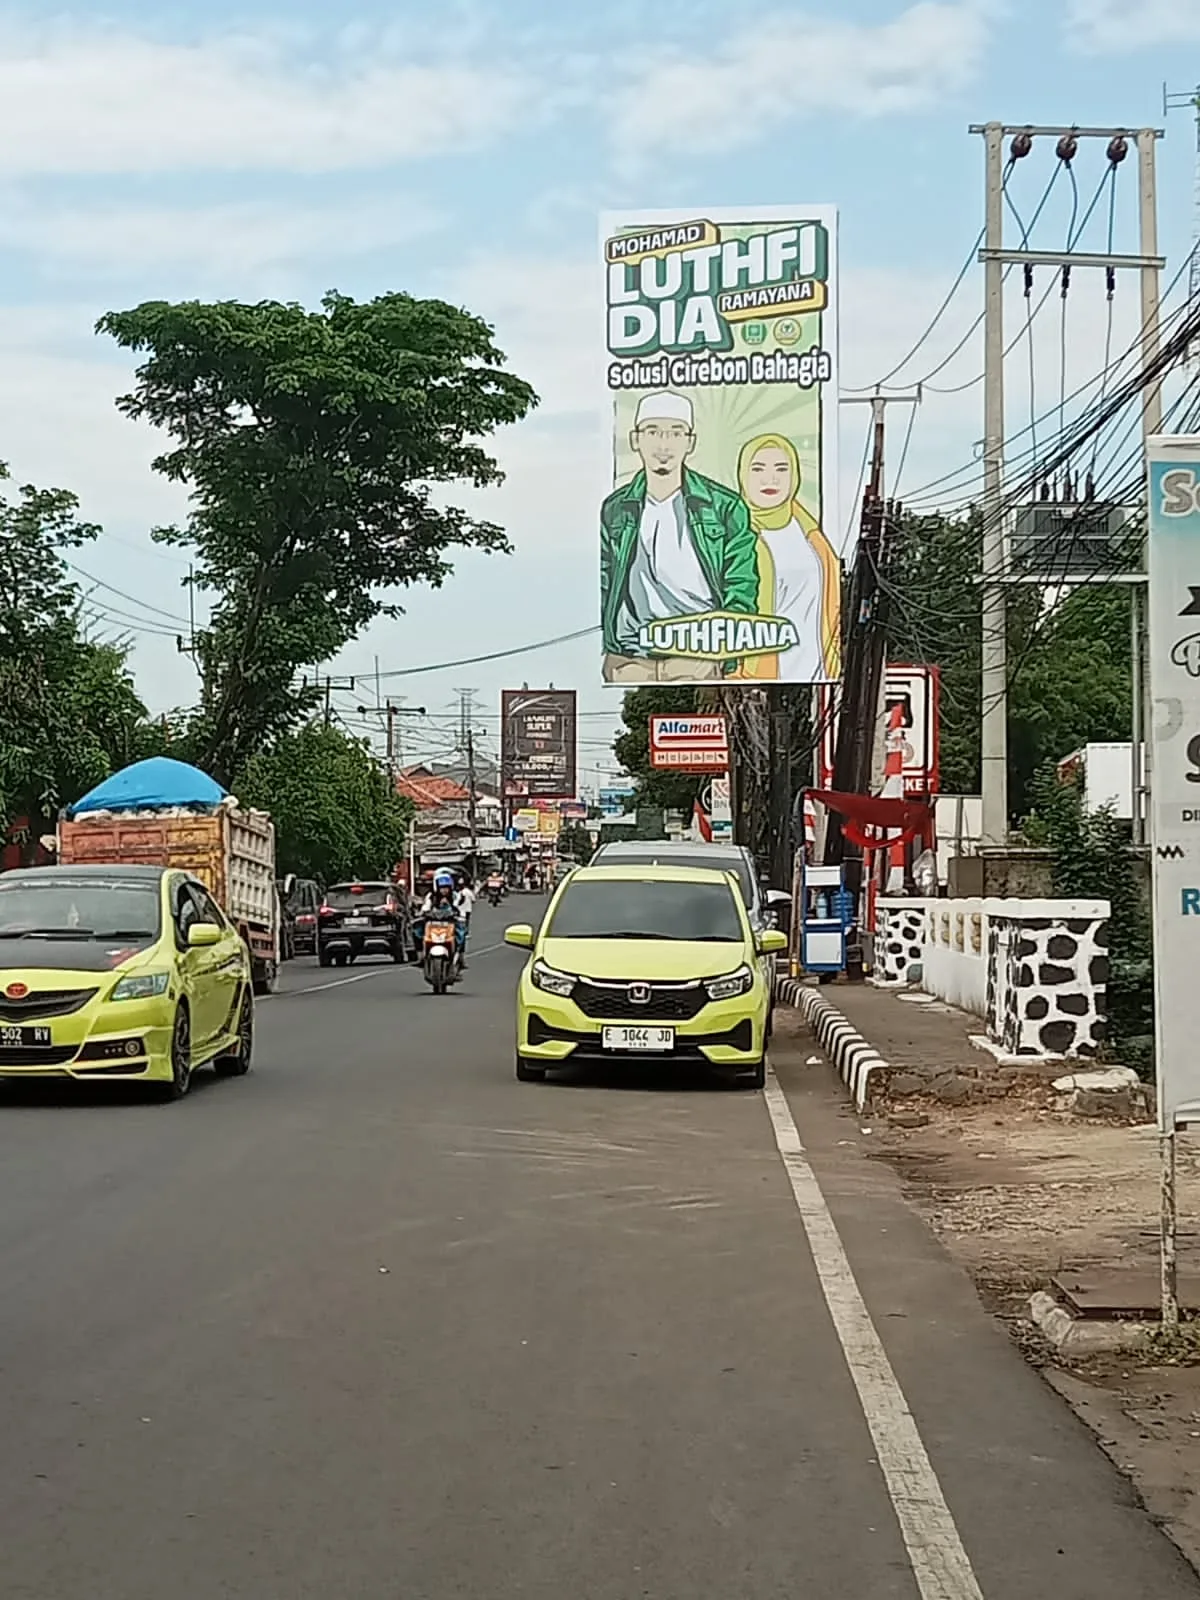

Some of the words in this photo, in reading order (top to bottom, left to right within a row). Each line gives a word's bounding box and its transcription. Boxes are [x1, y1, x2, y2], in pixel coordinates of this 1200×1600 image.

[611, 225, 701, 258] MOHAMAD
[609, 225, 817, 305] LUTHFI
[721, 282, 812, 312] RAMAYANA
[609, 295, 723, 349] DIA
[609, 360, 667, 387] Solusi
[671, 356, 748, 383] Cirebon
[752, 351, 830, 386] Bahagia
[639, 618, 799, 653] LUTHFIANA
[658, 719, 725, 734] Alfamart
[605, 1029, 612, 1041] E
[622, 1029, 649, 1041] 1044
[657, 1030, 671, 1042] JD
